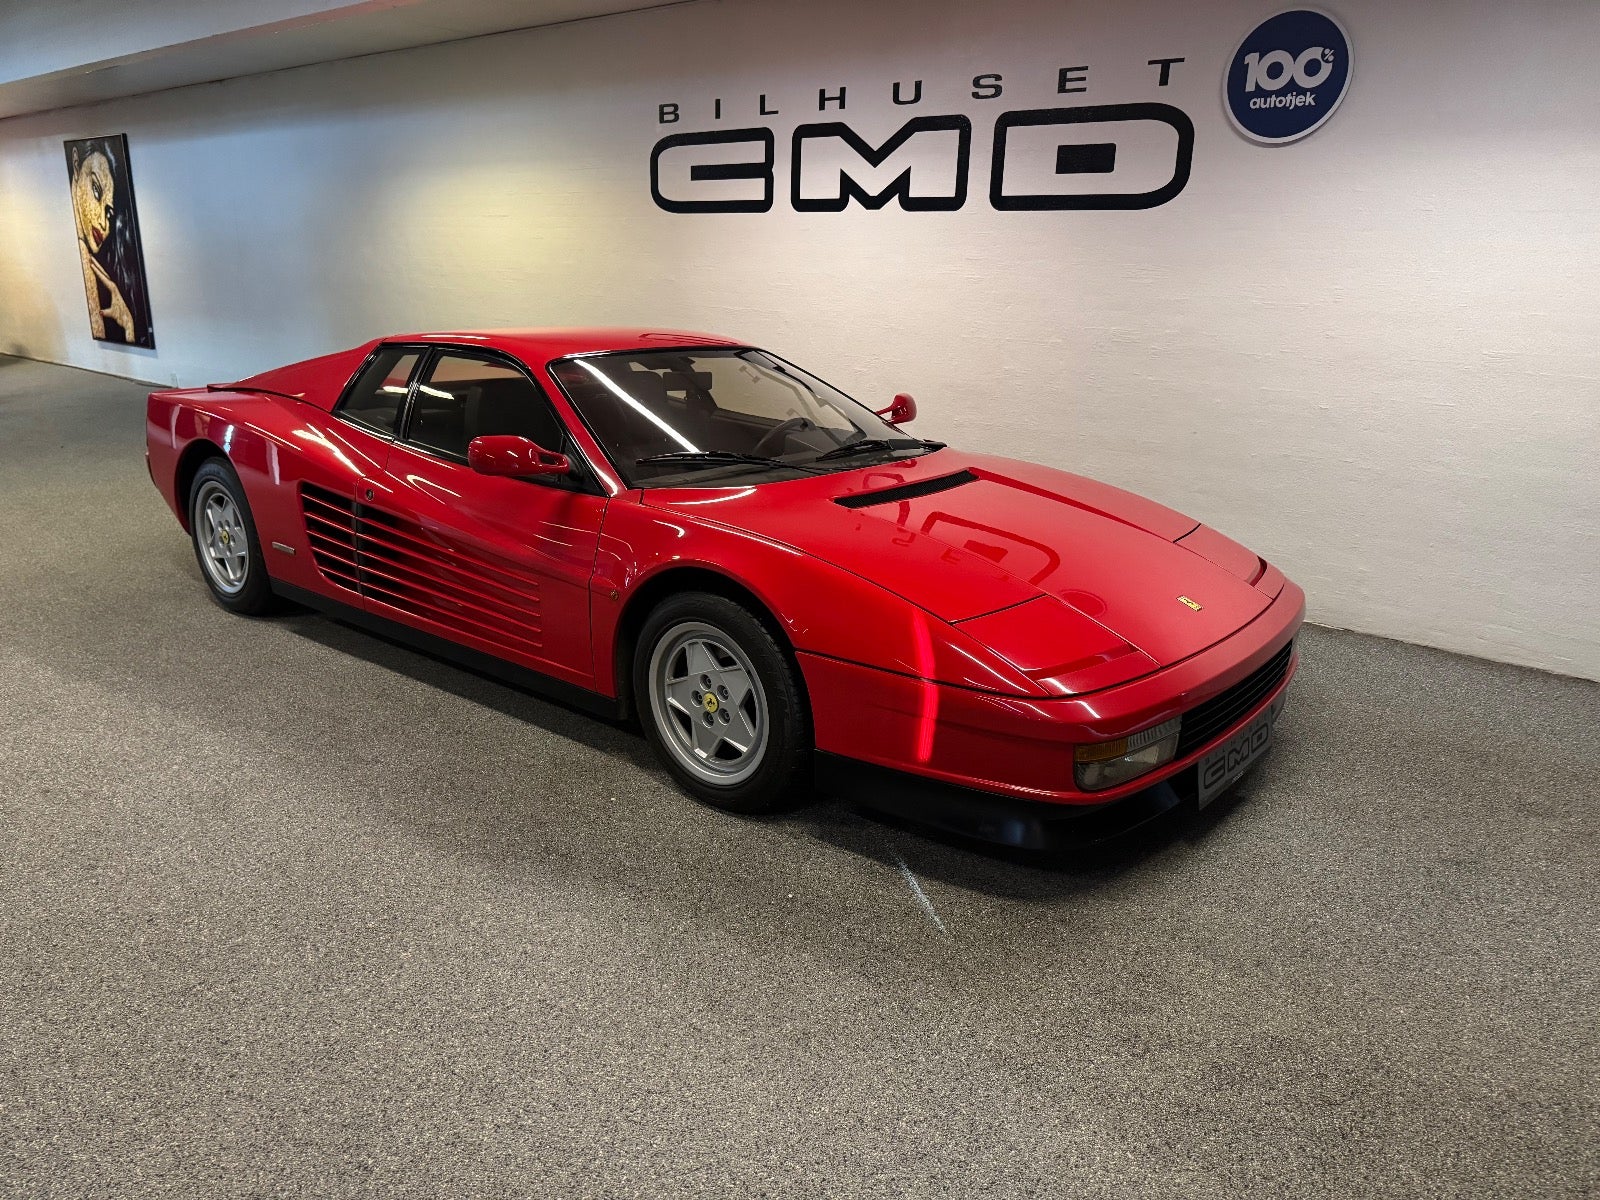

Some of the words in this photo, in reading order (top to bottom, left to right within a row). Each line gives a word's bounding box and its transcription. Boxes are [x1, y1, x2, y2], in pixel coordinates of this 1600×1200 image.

[658, 57, 1186, 124] BILHUSET
[1249, 92, 1316, 110] autotjek
[650, 101, 1195, 213] CMD
[1203, 722, 1269, 790] CMD
